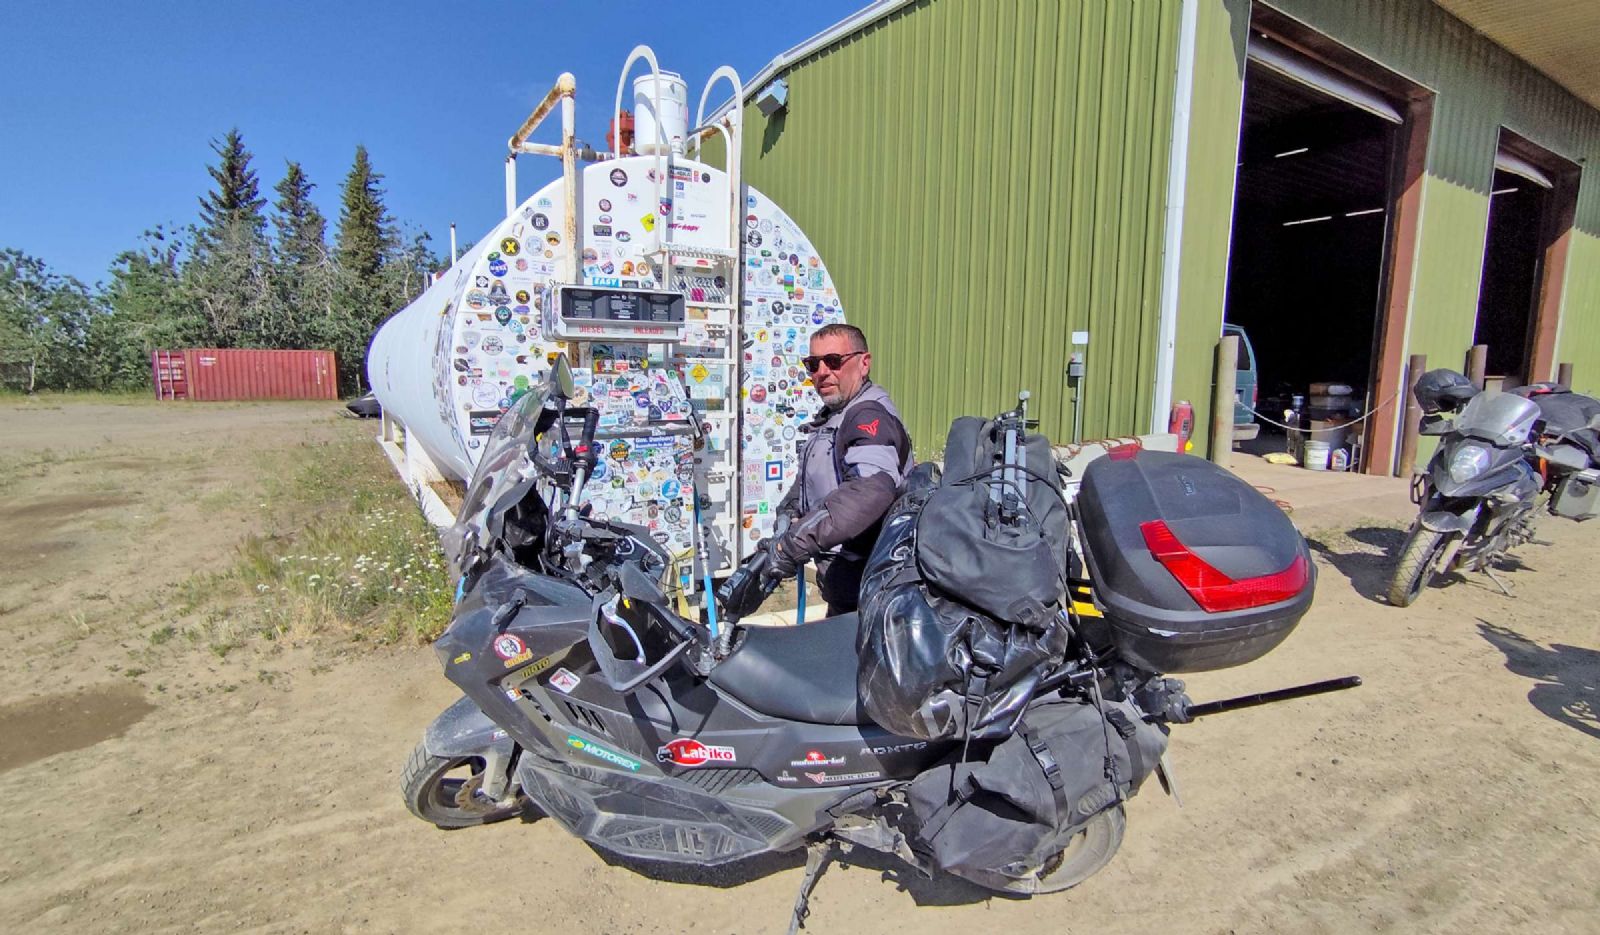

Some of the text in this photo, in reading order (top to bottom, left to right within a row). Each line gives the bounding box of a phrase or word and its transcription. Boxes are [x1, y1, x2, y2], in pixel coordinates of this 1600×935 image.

[578, 325, 606, 334] DIESEL
[633, 326, 665, 335] UNLEADED
[584, 743, 638, 770] MOTOREX
[680, 745, 734, 760] Labiko
